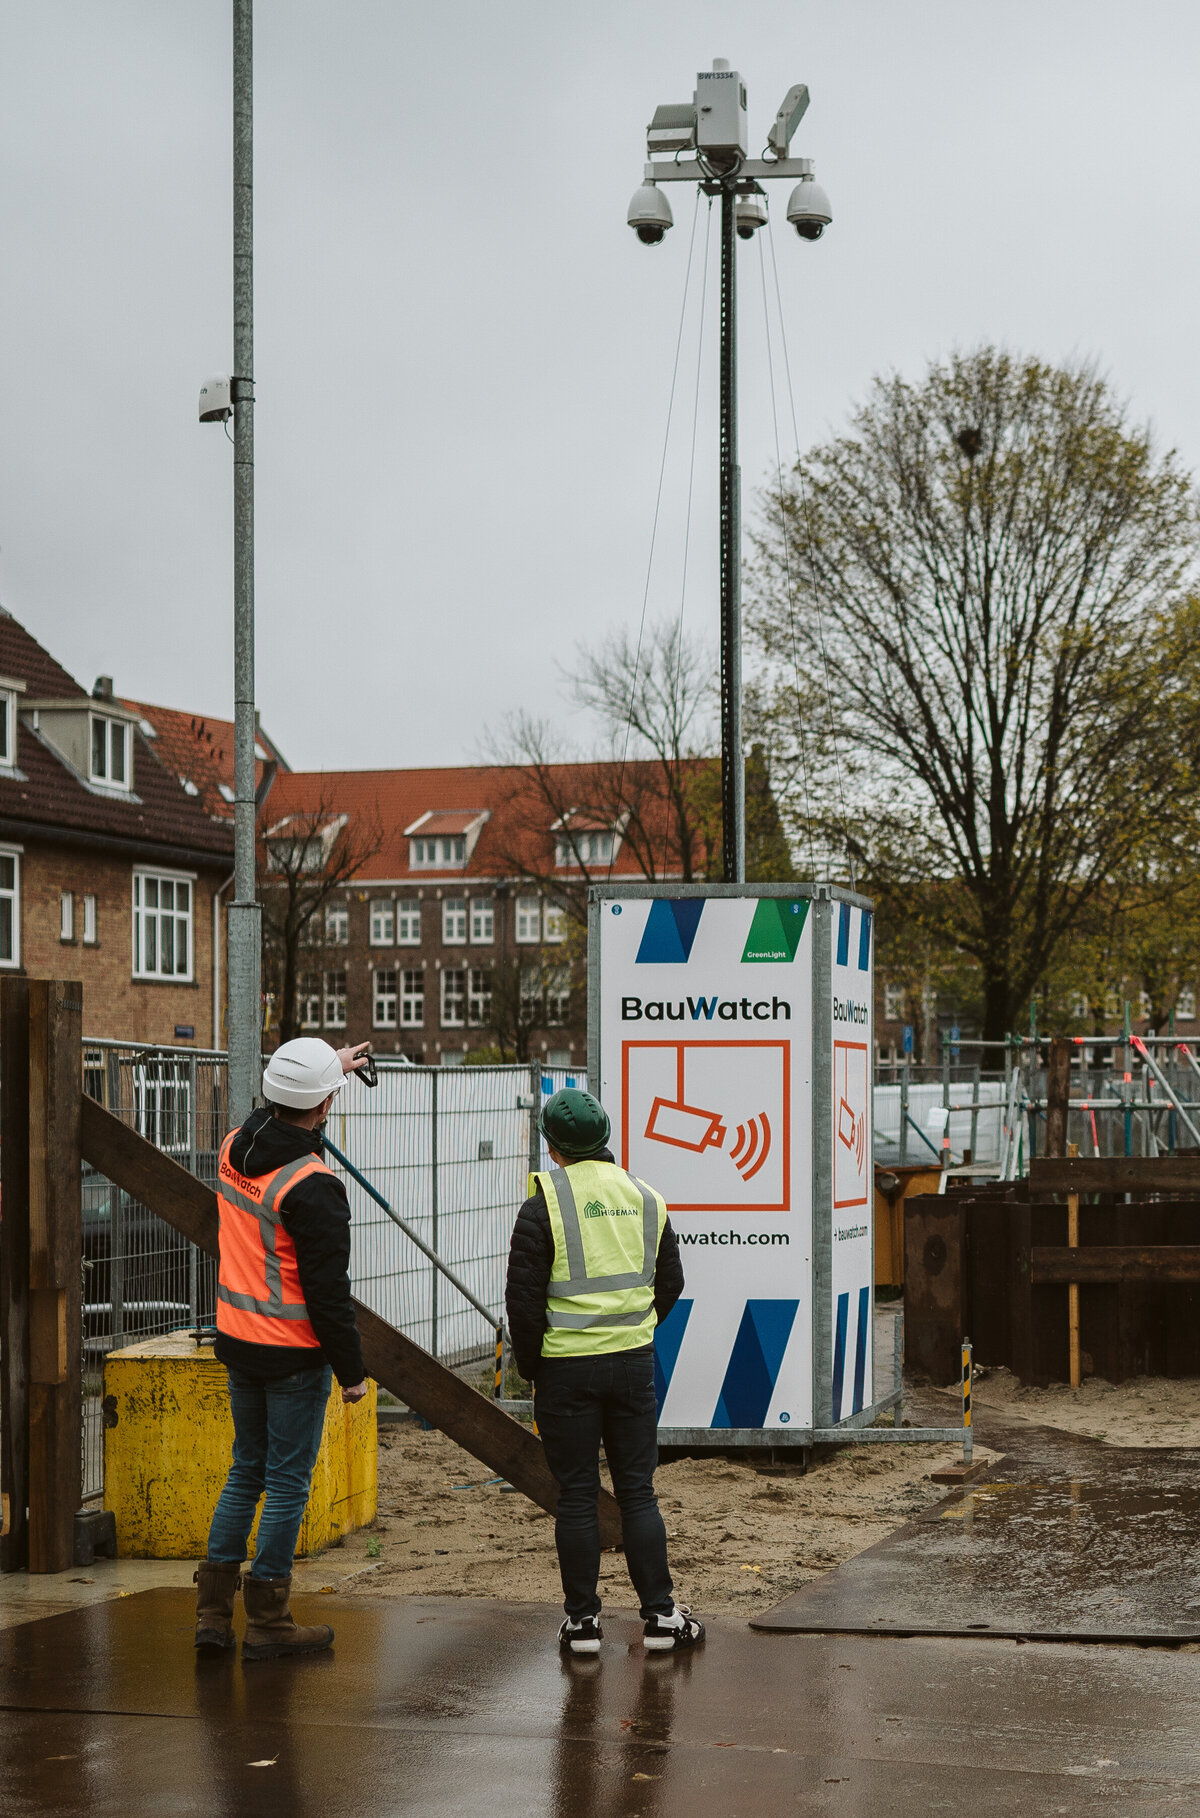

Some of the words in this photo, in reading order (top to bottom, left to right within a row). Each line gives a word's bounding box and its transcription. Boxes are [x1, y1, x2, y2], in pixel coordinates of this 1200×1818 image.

[747, 951, 787, 960] GreenLight
[621, 996, 791, 1021] BauWatch
[833, 997, 869, 1025] BauWatch
